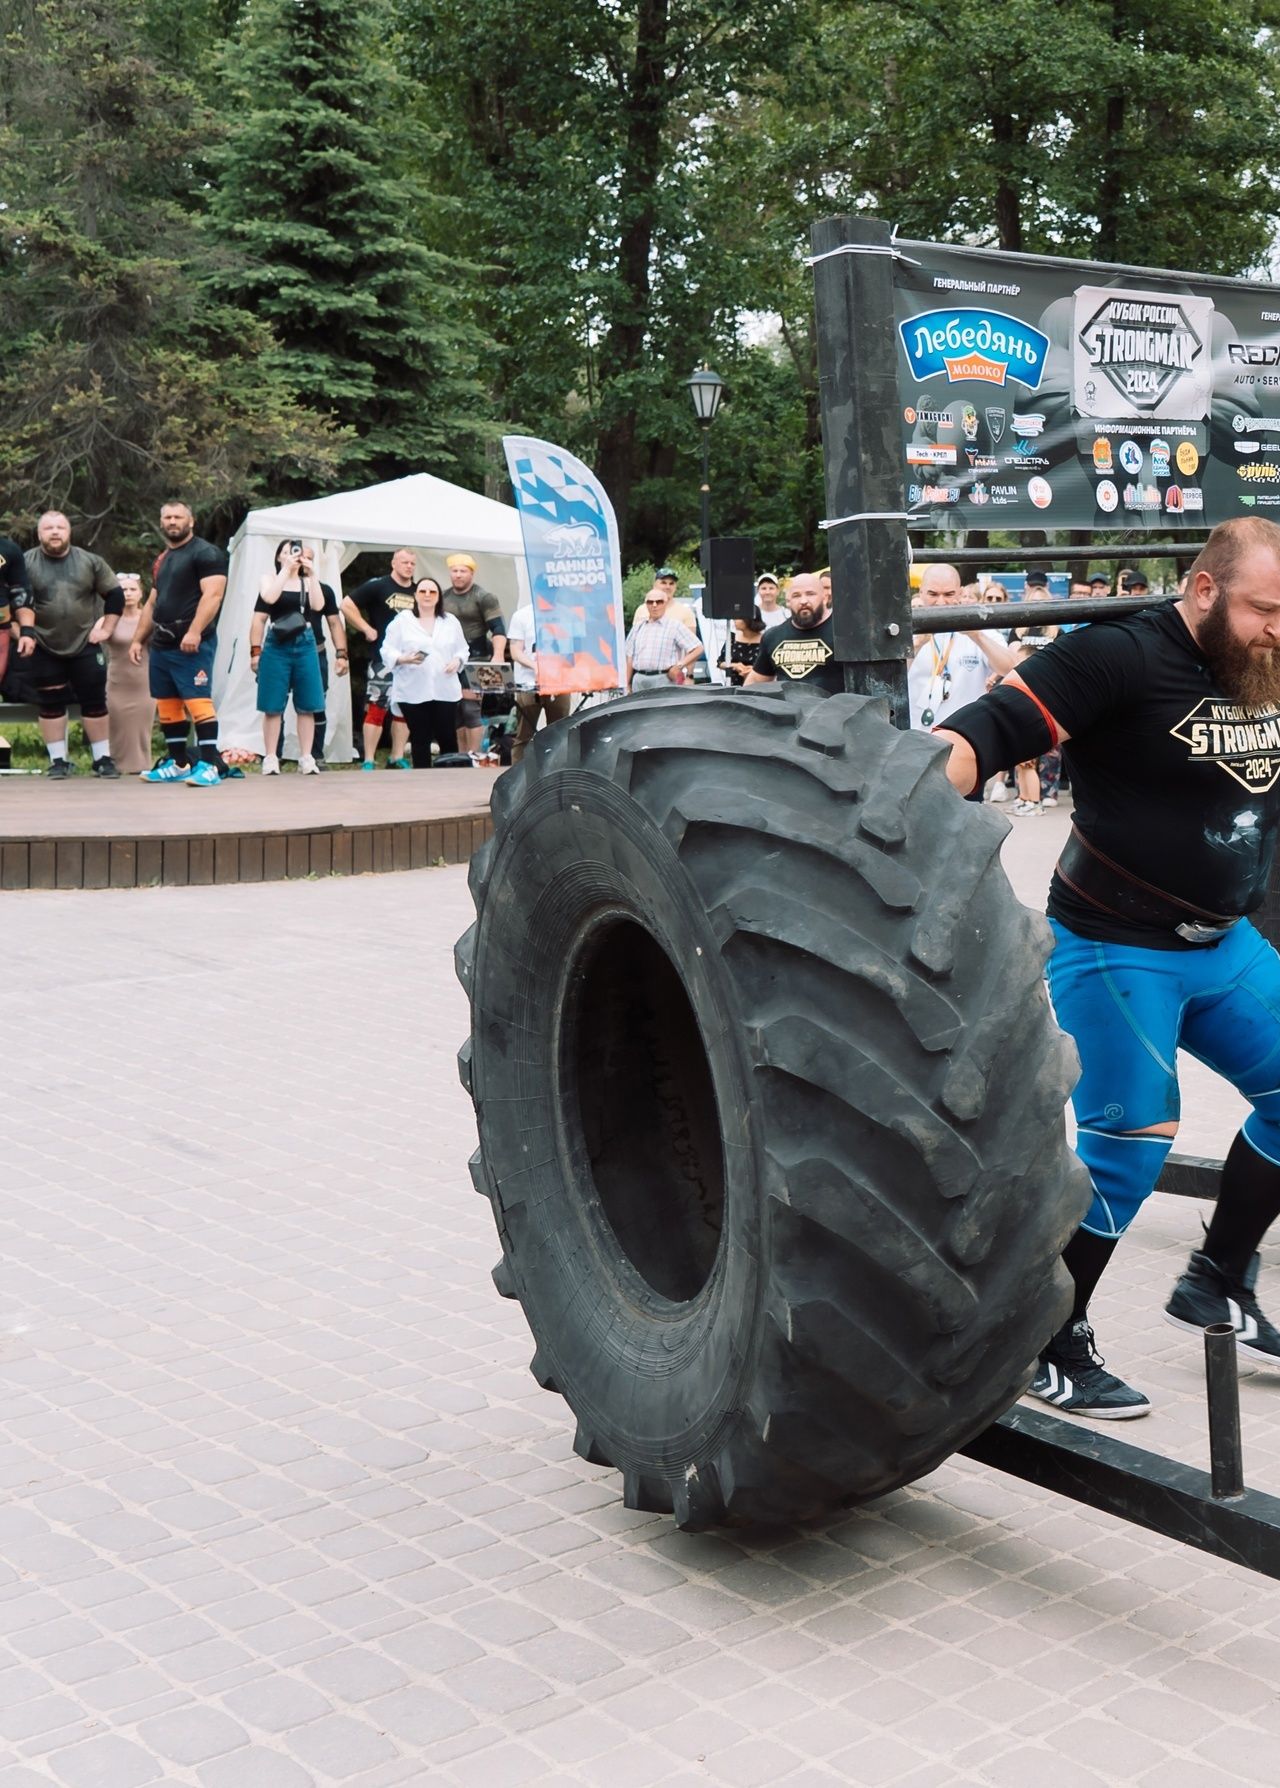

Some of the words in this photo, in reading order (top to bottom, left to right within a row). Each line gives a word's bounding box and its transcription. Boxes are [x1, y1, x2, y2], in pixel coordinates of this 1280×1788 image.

[933, 277, 987, 292] ГЕНЕРАЛЬНЫЙ
[987, 282, 1021, 296] ПАРТНЁР
[1108, 301, 1142, 321] КУБОК
[1143, 304, 1180, 325] РОССИИ
[913, 317, 1038, 365] Лебедянь
[1089, 325, 1194, 369] STRONGMAN
[1127, 369, 1159, 393] 2024
[1233, 375, 1255, 385] AUTO
[1094, 424, 1161, 435] ИНФОРМАЦИОННЫЕ
[1162, 425, 1197, 436] ПАРТНЁРЫ
[991, 485, 1017, 495] PAVLIN
[774, 648, 826, 665] STRONGMAN
[1211, 704, 1244, 721] КУБОК
[1245, 757, 1272, 780] 2024
